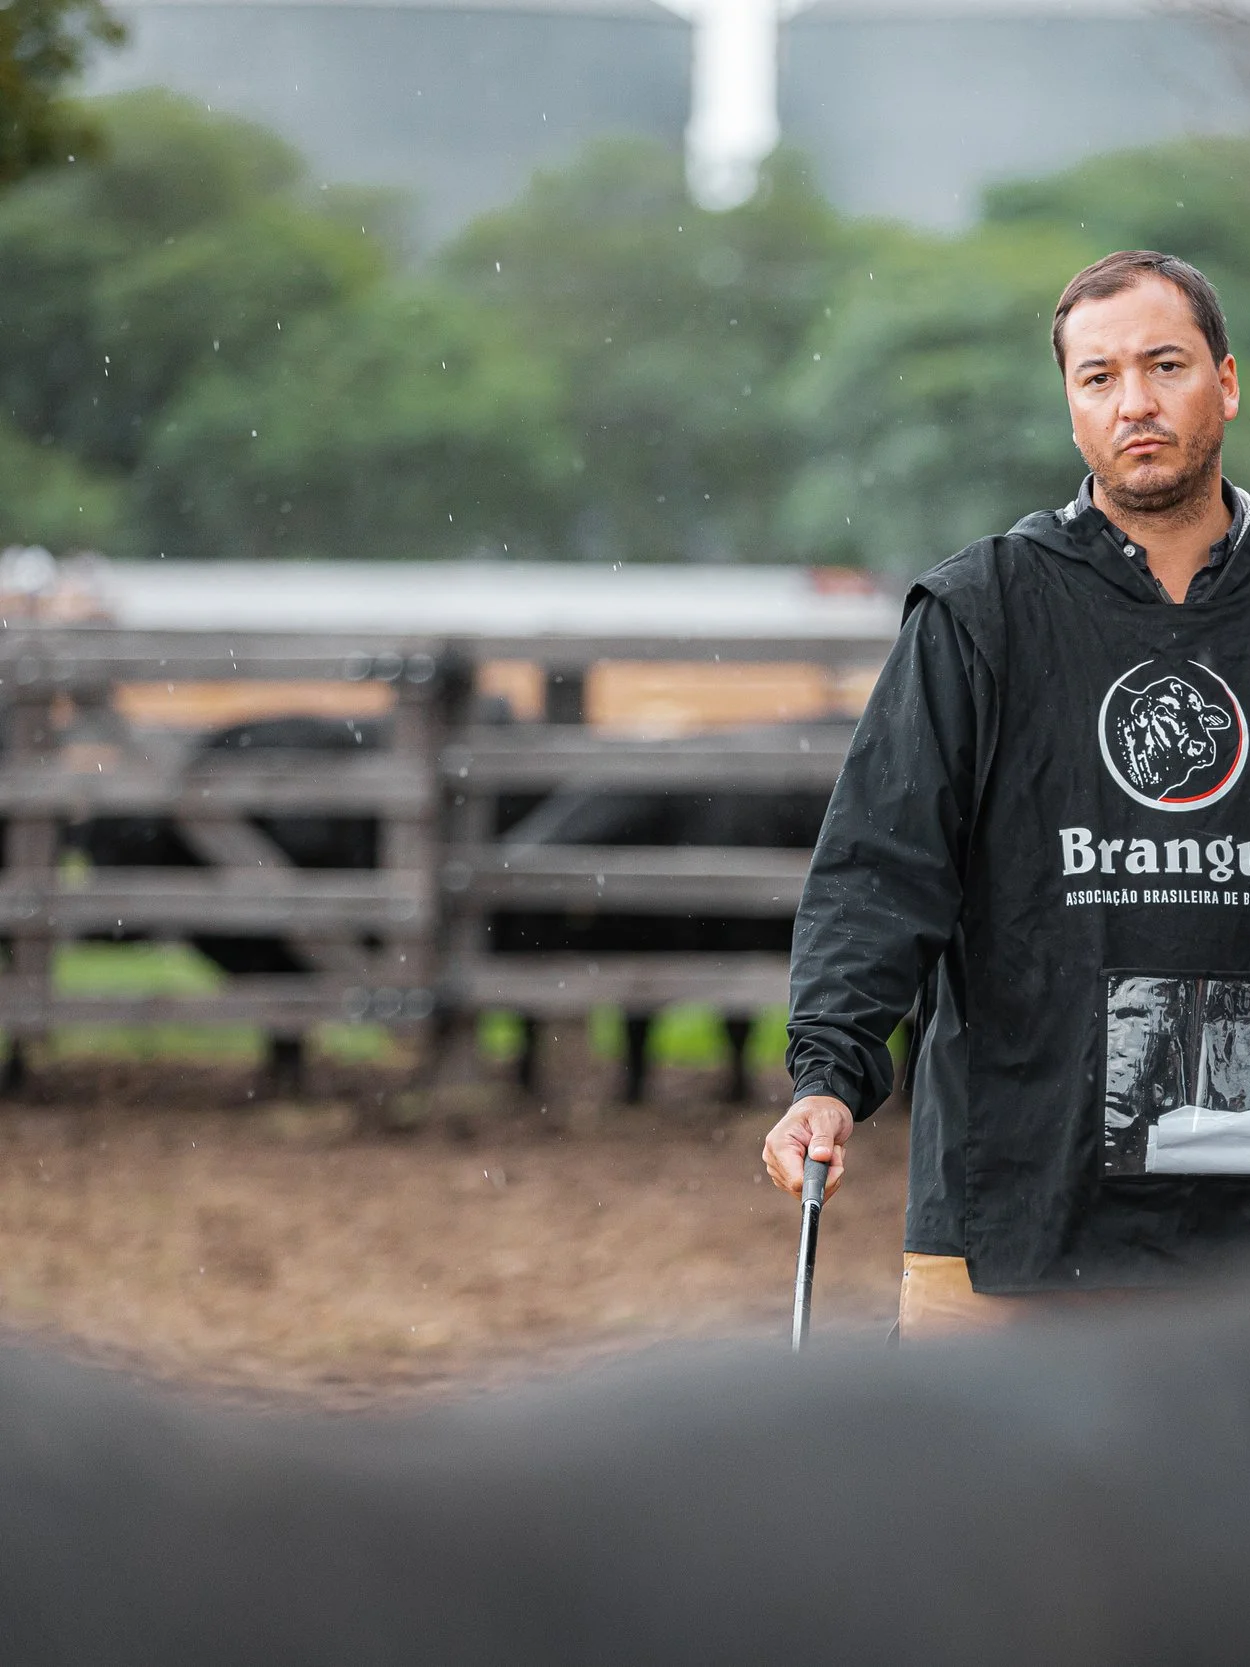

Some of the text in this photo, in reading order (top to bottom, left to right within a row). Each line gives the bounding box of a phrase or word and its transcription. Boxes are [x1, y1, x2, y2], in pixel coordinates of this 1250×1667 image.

[1066, 888, 1137, 906] ASSOCIAÇÃO
[1143, 889, 1219, 904] BRASILEIRA
[1224, 891, 1239, 905] DE
